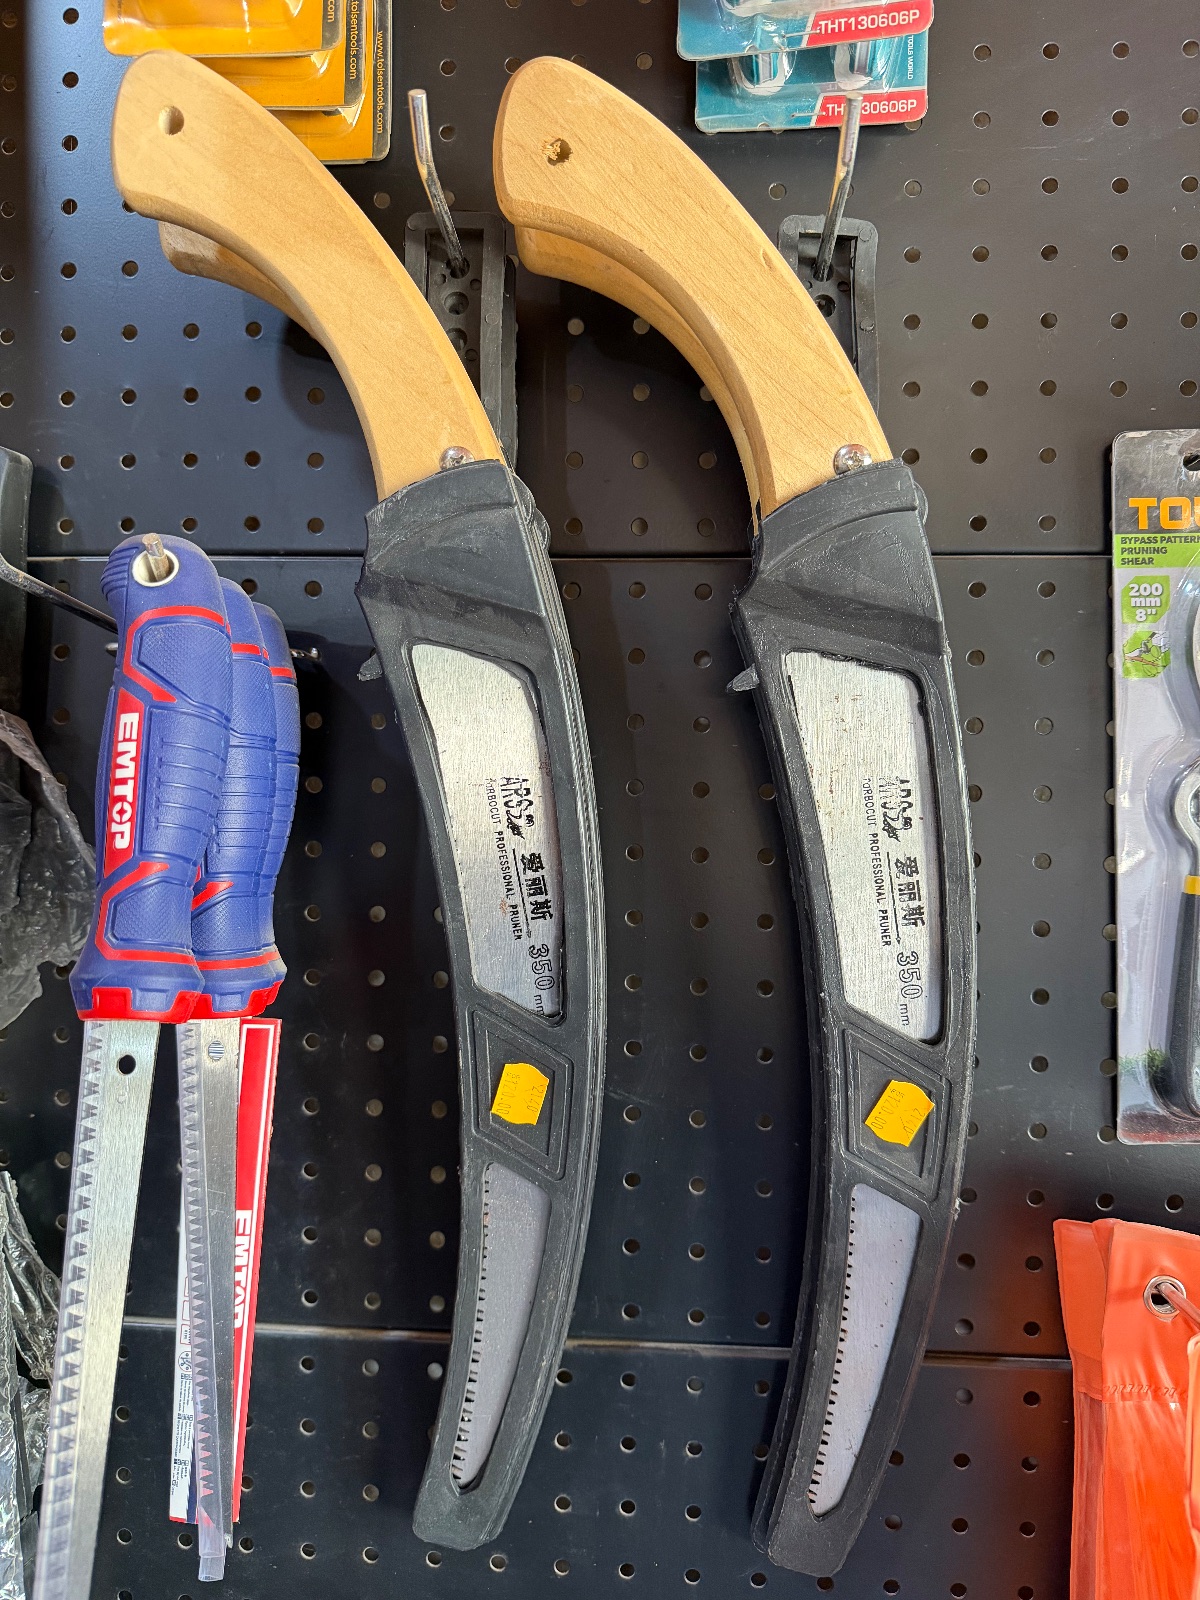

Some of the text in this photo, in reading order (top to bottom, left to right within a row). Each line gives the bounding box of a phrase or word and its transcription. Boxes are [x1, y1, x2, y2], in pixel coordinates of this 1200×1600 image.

[819, 9, 920, 35] THT130606P
[376, 31, 385, 134] www.tolsentools.com
[826, 99, 917, 117] TH30606P
[1128, 496, 1200, 530] TO
[1120, 536, 1158, 545] BYPASS
[1120, 546, 1167, 555] PRUNING
[1120, 557, 1154, 566] SHEAR
[1128, 583, 1163, 597] 200
[1130, 597, 1161, 607] mm
[110, 712, 140, 850] EMTOP
[493, 830, 516, 900] PROFESSIONAL
[868, 832, 887, 903] PROFESSIONAL
[878, 908, 892, 947] PRUNER
[528, 943, 556, 991] 350
[896, 950, 924, 1000] 350
